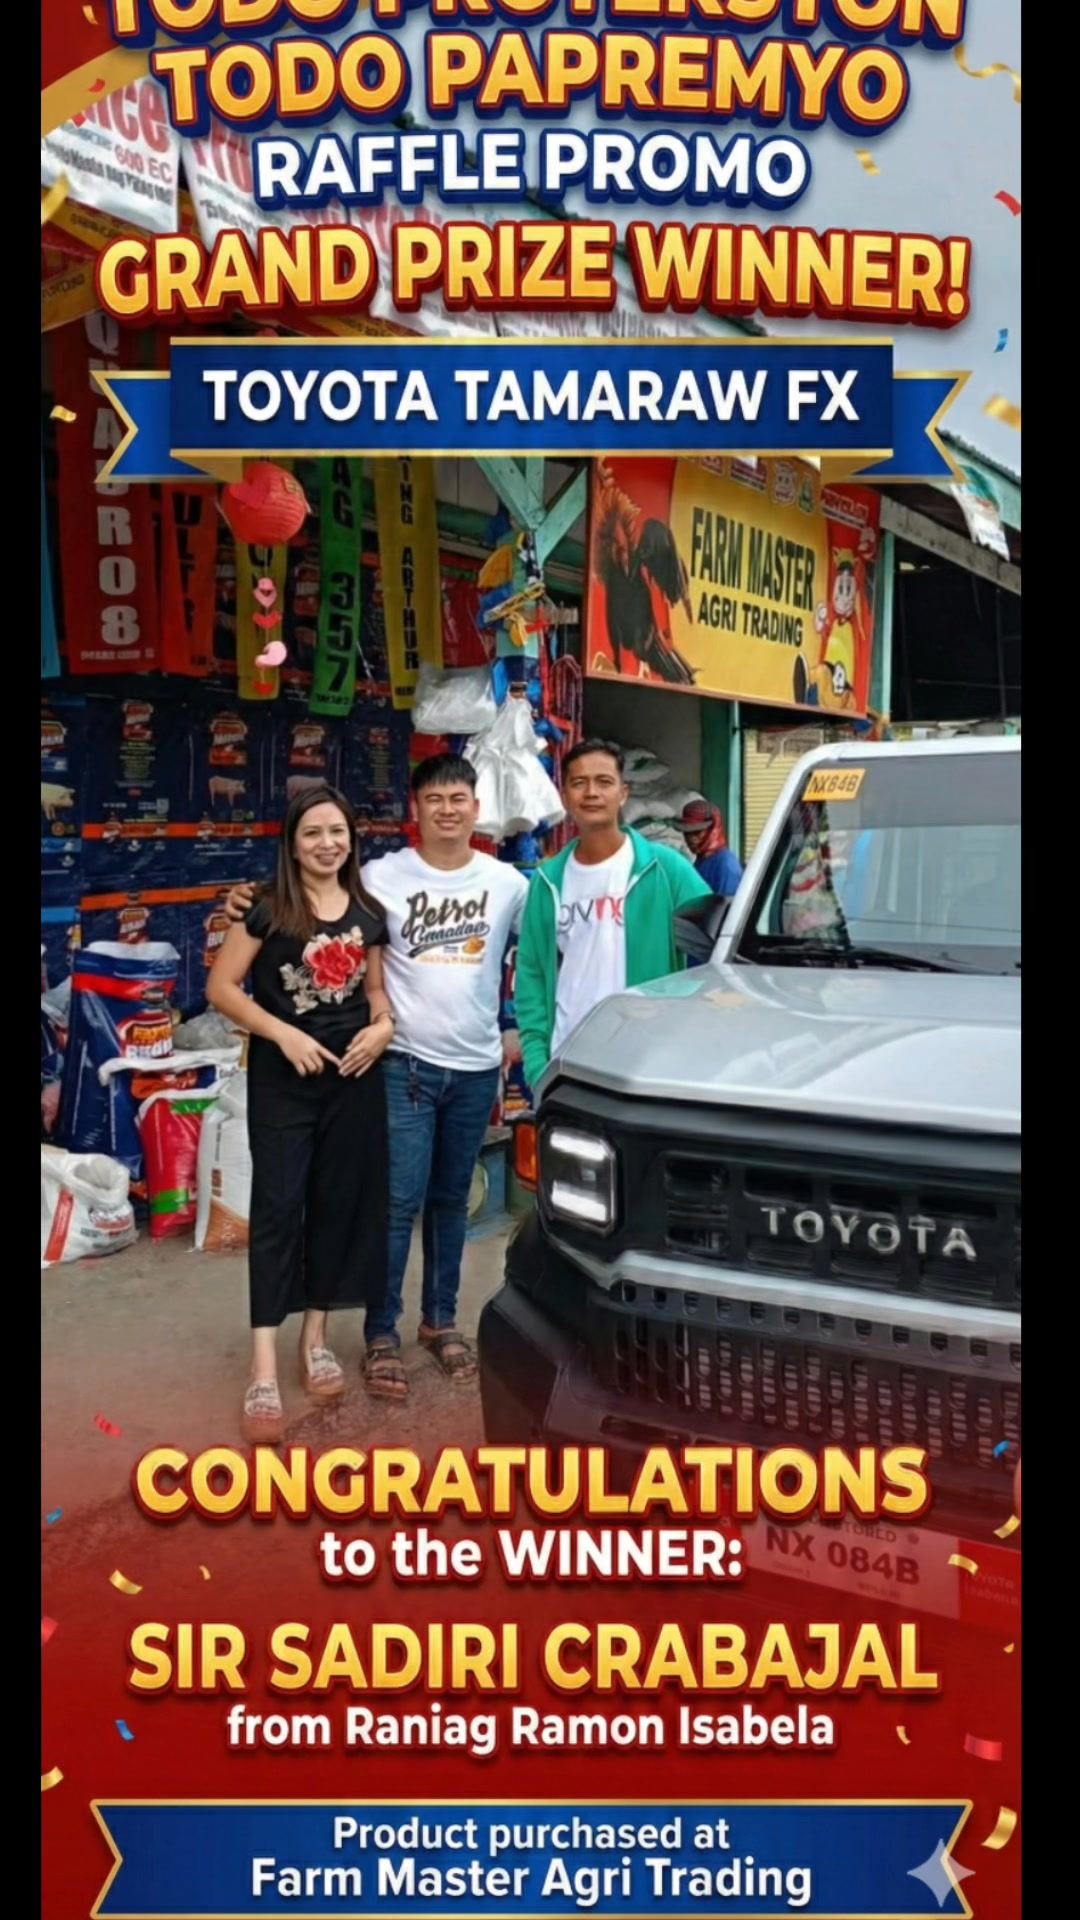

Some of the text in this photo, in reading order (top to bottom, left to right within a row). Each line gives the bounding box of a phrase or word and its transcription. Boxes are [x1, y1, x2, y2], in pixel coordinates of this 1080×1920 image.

[691, 506, 745, 589] FARM
[746, 525, 816, 612] MASTER
[697, 591, 804, 648] AGRI TRADING
[401, 889, 489, 939] Petrol
[760, 1205, 977, 1262] TOYOTA
[766, 1526, 815, 1562] NX
[827, 1540, 920, 1586] 084B
